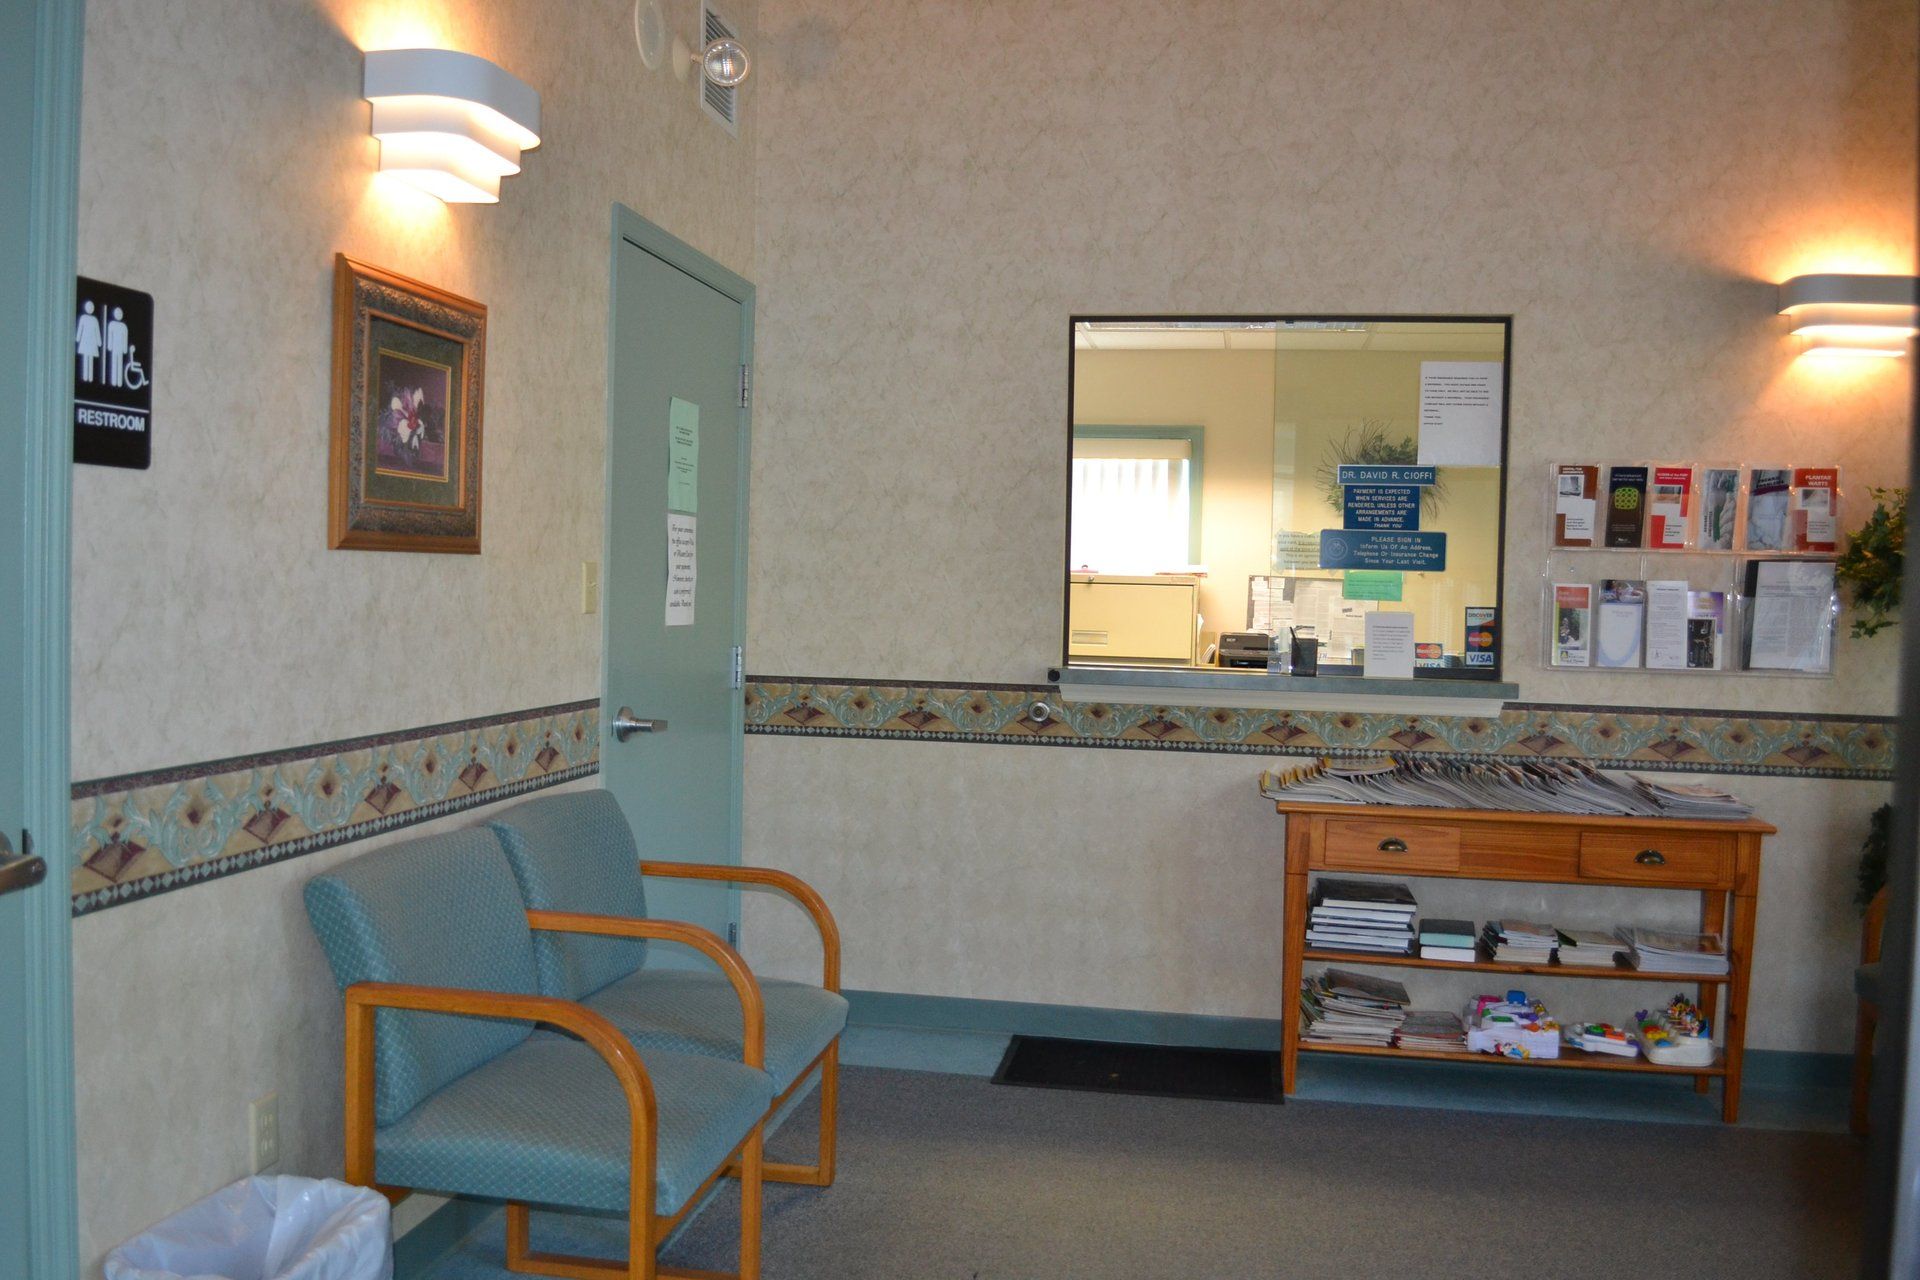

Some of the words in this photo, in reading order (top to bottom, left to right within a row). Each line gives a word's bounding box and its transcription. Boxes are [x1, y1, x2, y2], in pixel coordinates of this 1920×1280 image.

[78, 408, 145, 432] RESTROOM
[1342, 471, 1356, 479] DR.
[1360, 471, 1388, 479] DAVID
[1392, 471, 1400, 479] R.
[1403, 472, 1432, 480] CIOFFI
[1469, 654, 1492, 663] VISA
